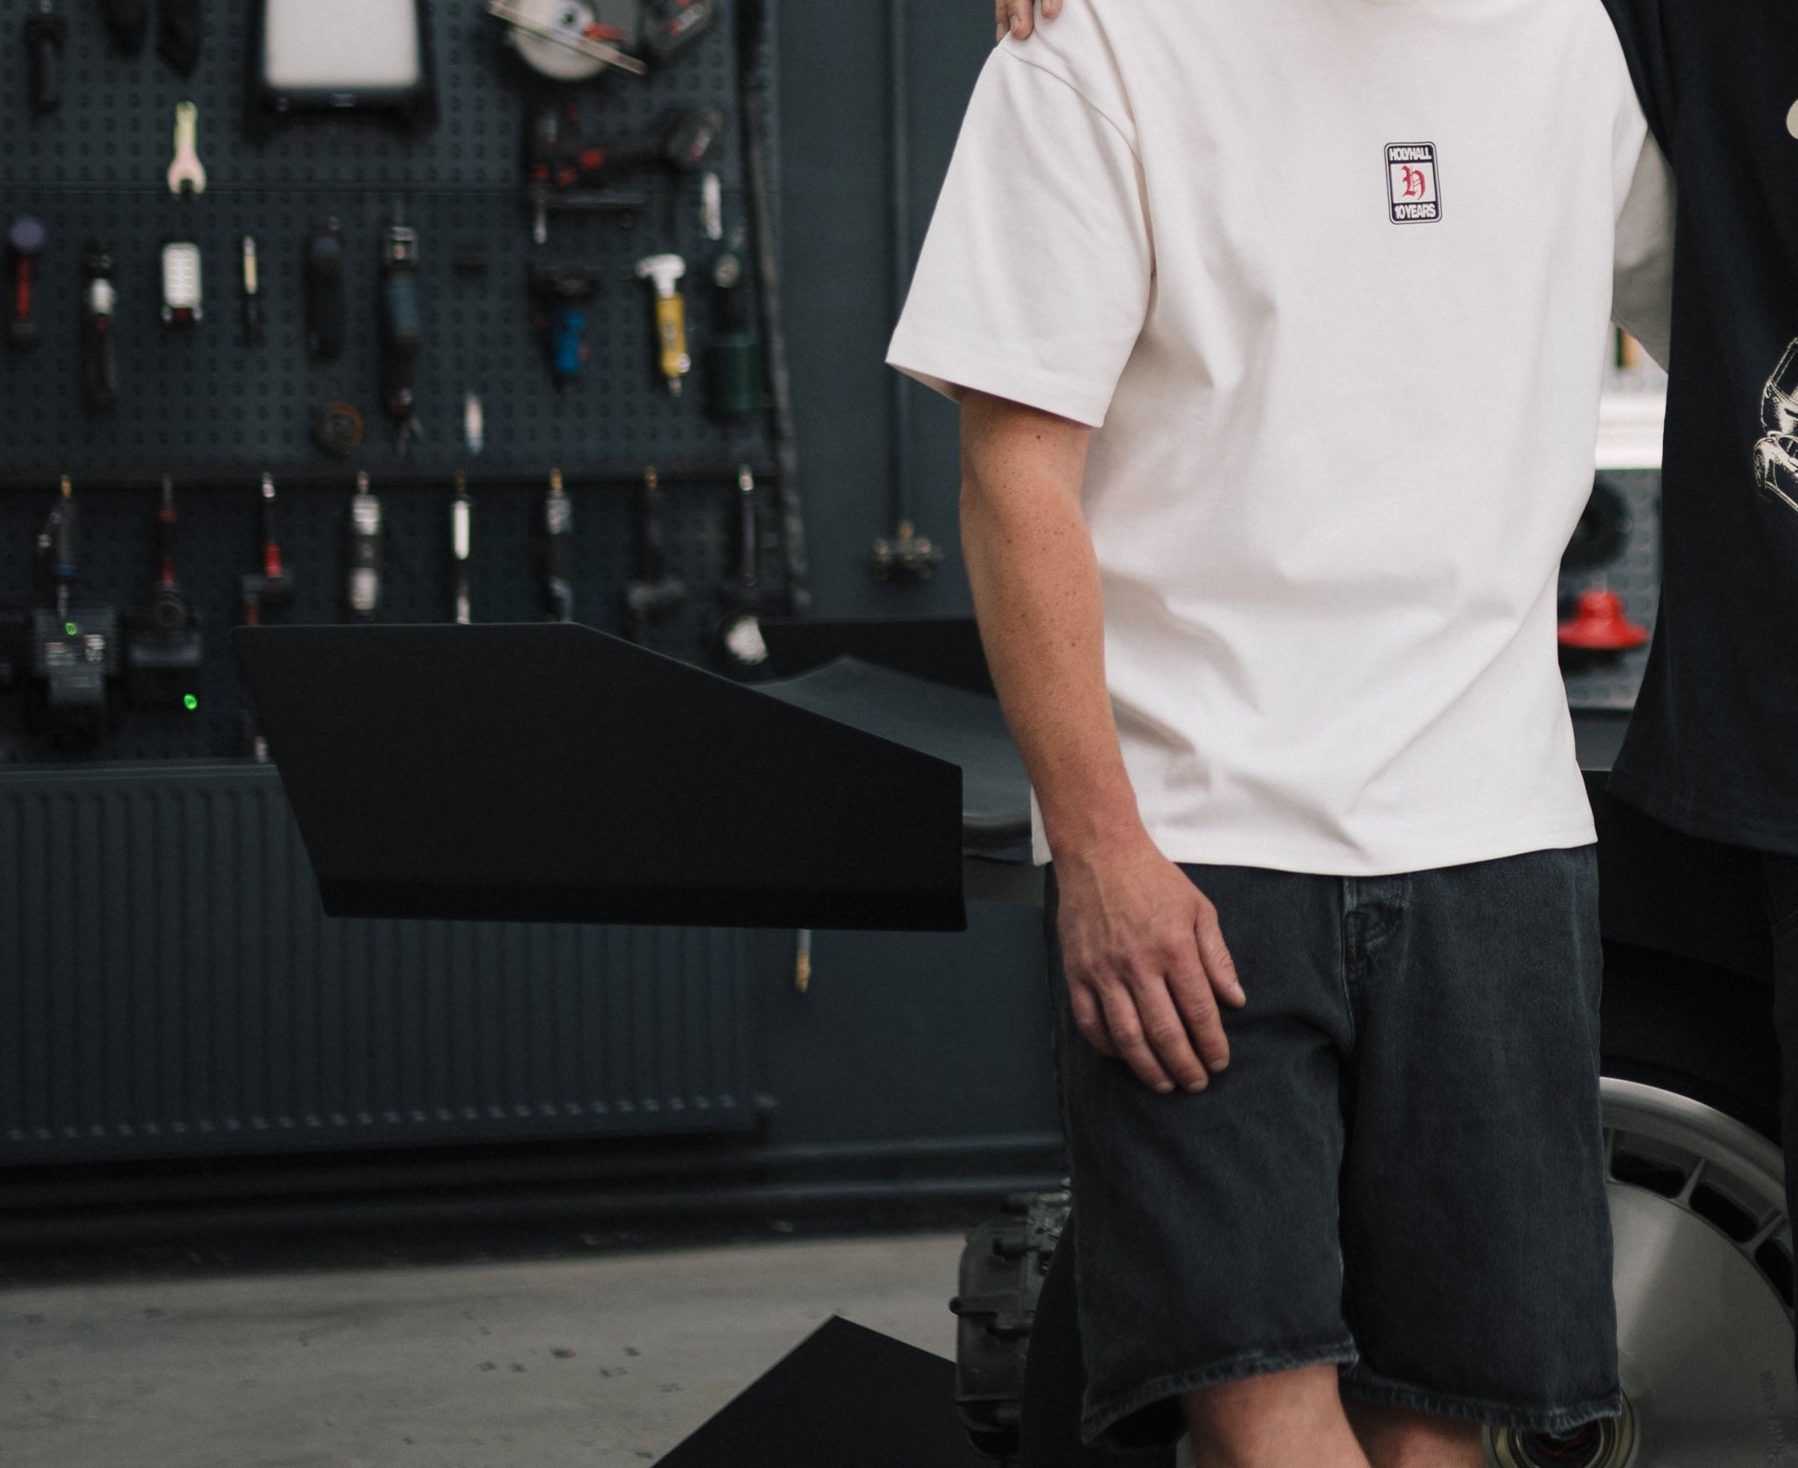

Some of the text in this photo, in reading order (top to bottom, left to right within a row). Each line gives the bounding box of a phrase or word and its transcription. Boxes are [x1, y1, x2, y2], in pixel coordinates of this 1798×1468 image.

[1389, 147, 1432, 161] HOLYHALL
[1394, 203, 1436, 219] 10 YEARS
